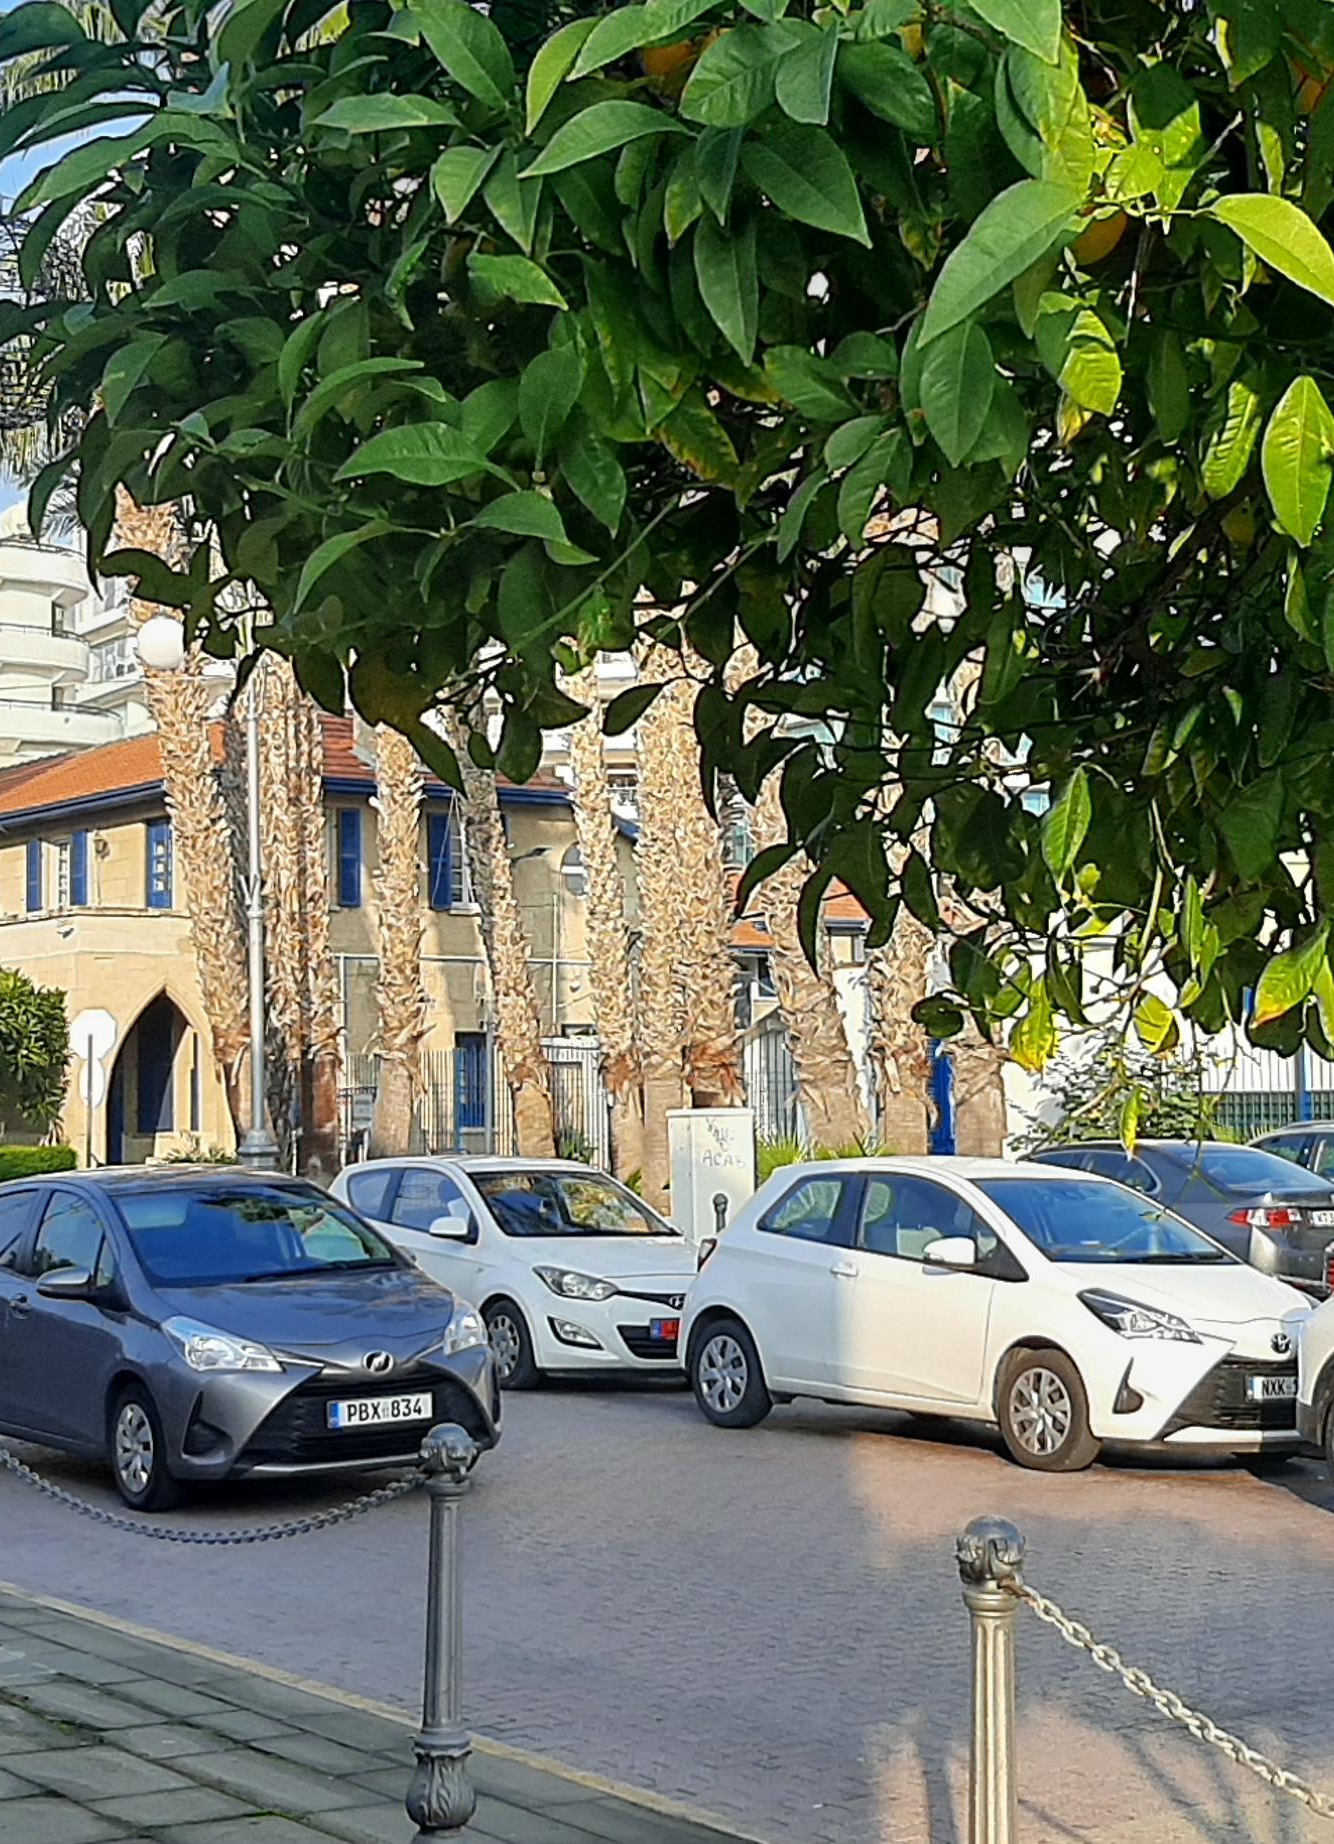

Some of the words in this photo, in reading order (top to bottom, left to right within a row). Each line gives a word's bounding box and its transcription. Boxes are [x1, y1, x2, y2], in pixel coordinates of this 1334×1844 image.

[1262, 1379, 1286, 1397] NXK
[347, 1402, 381, 1422] PBX
[391, 1398, 422, 1418] 834
